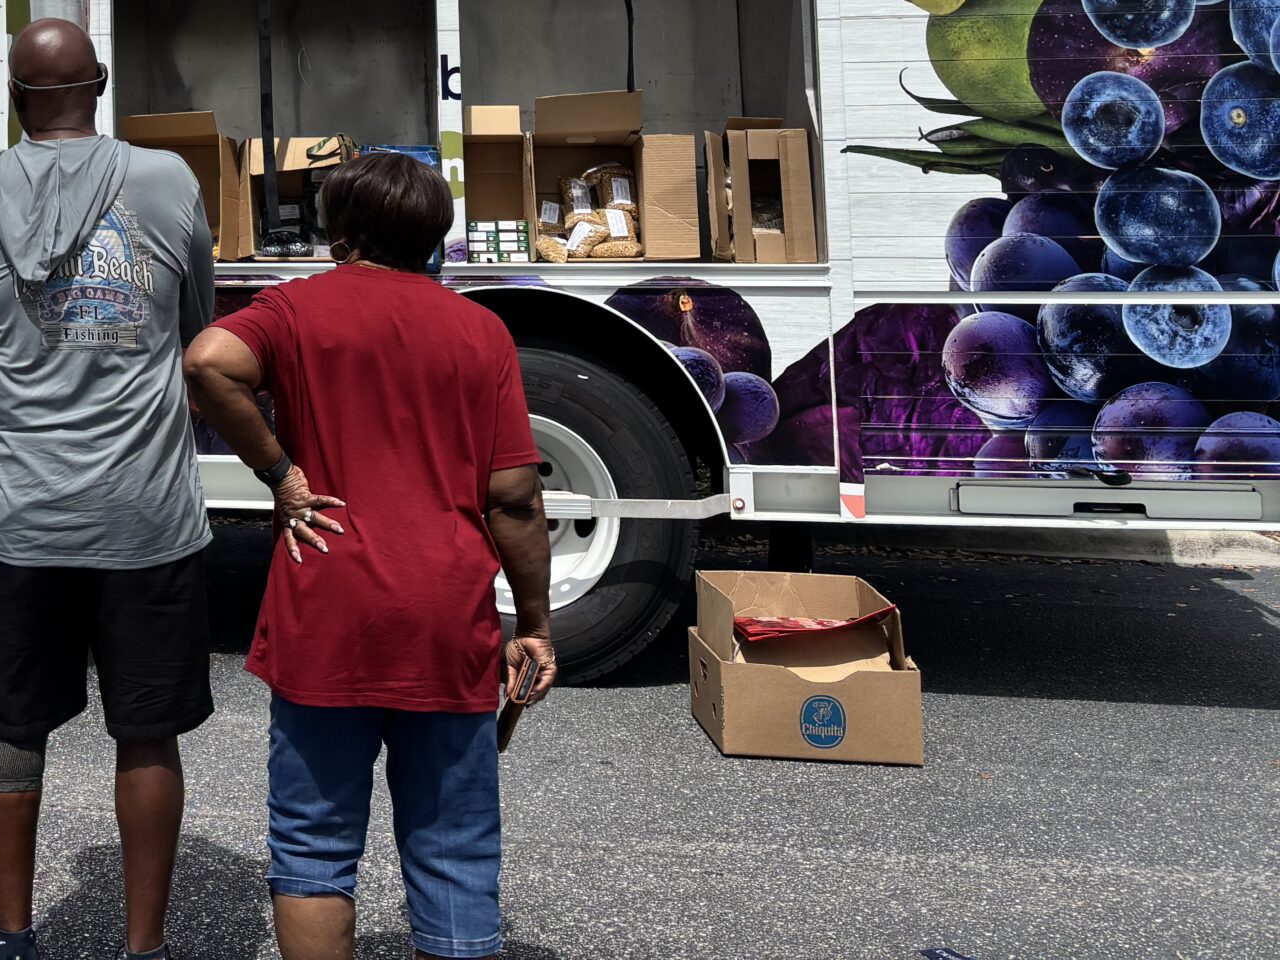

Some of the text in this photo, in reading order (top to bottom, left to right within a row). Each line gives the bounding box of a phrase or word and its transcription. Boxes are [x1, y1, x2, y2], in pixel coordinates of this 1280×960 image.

[88, 244, 154, 293] Beach
[85, 287, 125, 303] GAME
[62, 327, 119, 344] Fishing
[801, 723, 844, 739] Chiquita
